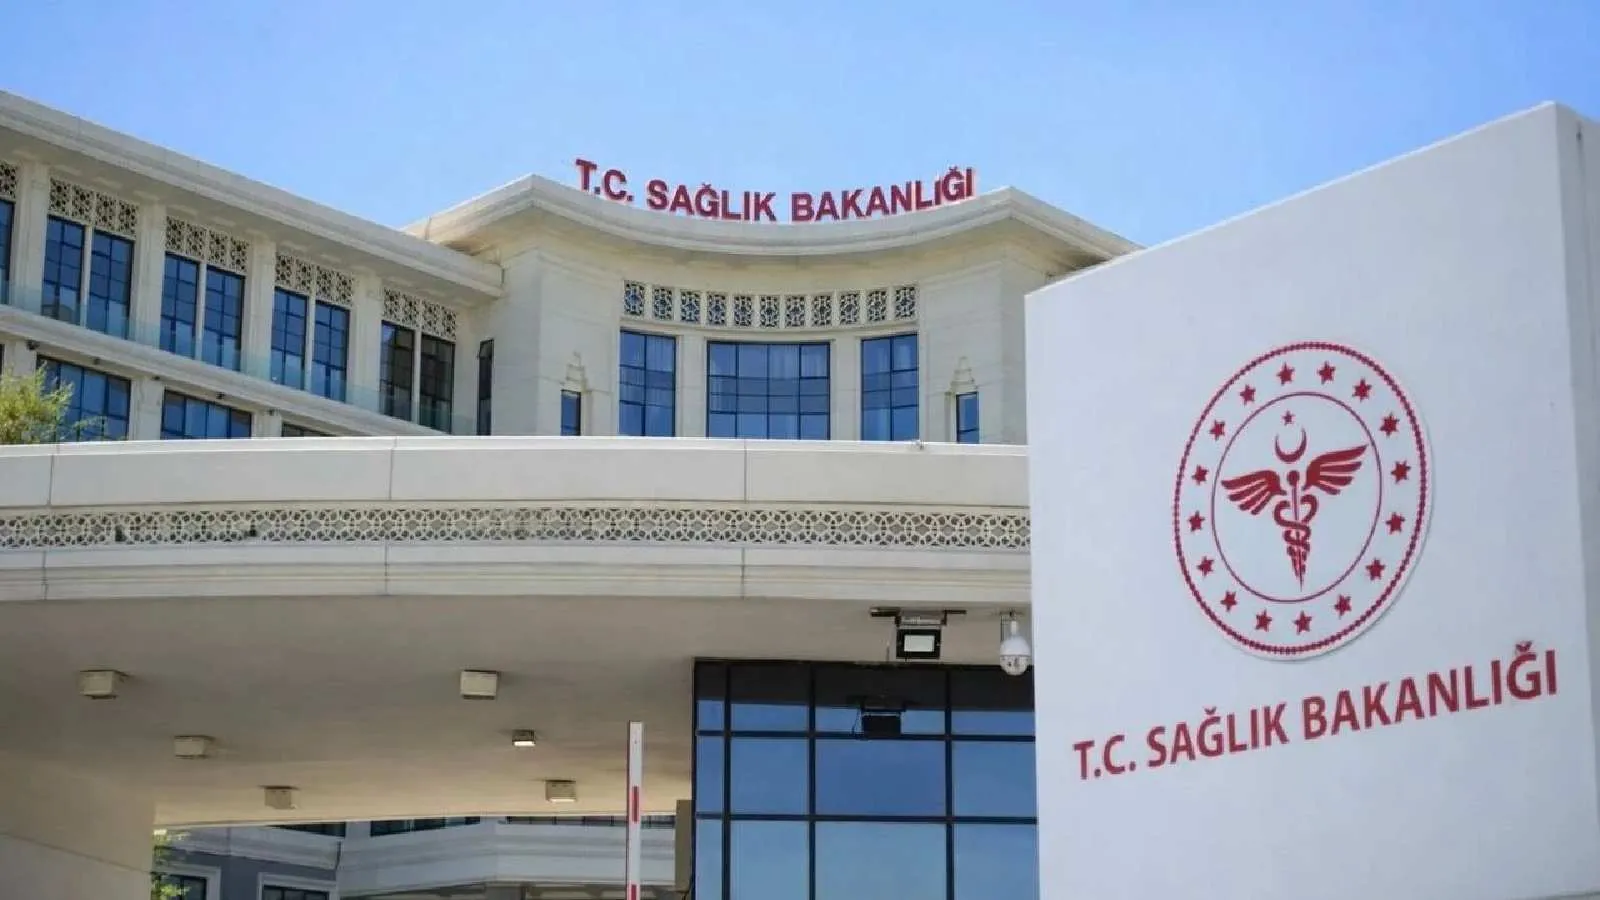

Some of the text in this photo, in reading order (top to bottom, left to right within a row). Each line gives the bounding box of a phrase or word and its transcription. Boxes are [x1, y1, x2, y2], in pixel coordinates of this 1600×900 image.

[575, 158, 975, 222] T.C. SAĞLIK BAKANLIĞI
[1073, 640, 1558, 780] T.C. SAĞLIK BAKANLIĞI
